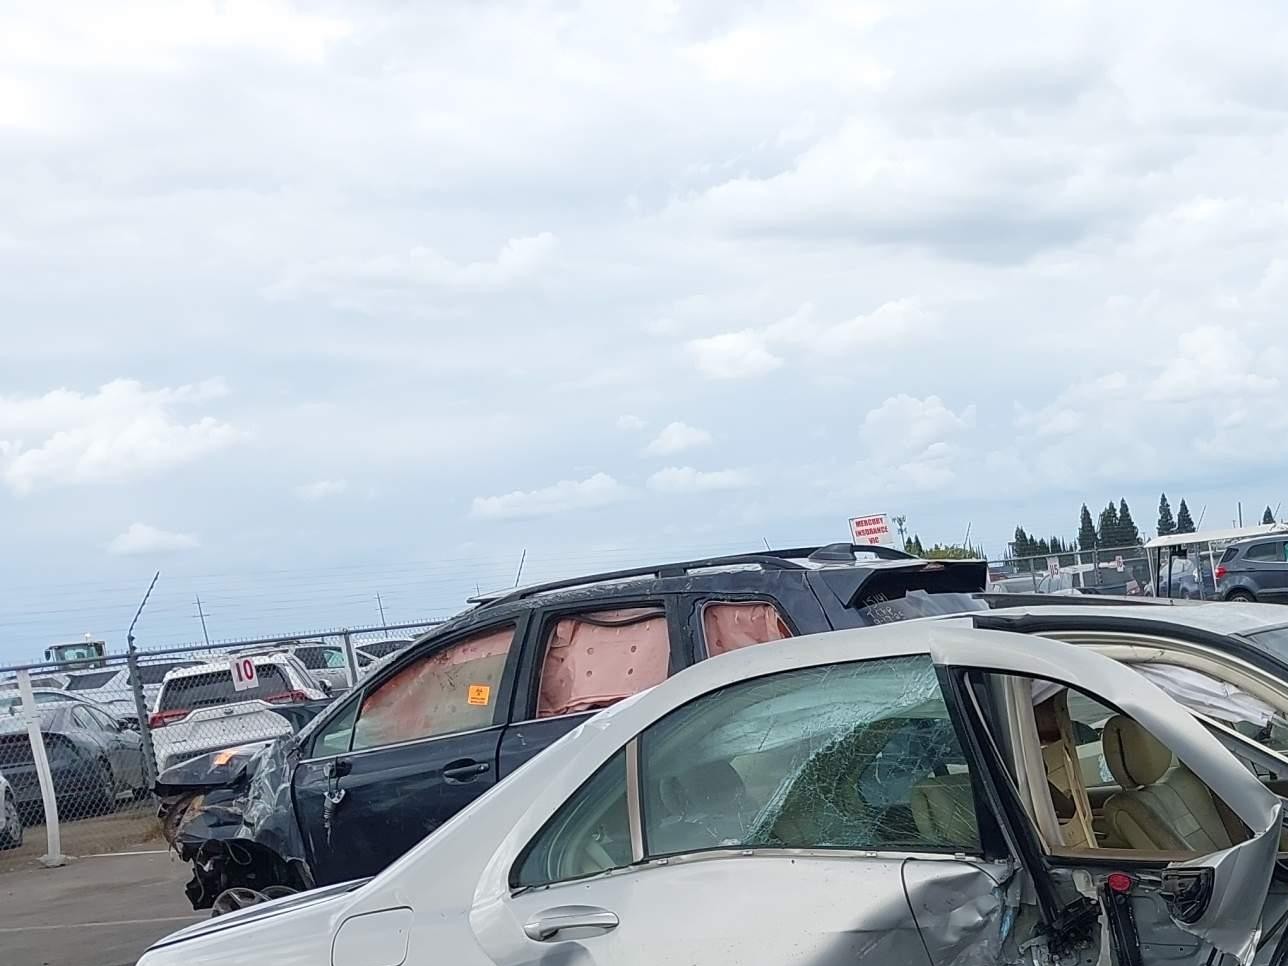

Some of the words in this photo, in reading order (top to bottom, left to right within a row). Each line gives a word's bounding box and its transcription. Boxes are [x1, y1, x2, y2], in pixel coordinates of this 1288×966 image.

[855, 518, 883, 527] MERCURY
[855, 526, 888, 537] INSURANCE
[236, 660, 254, 682] 10
